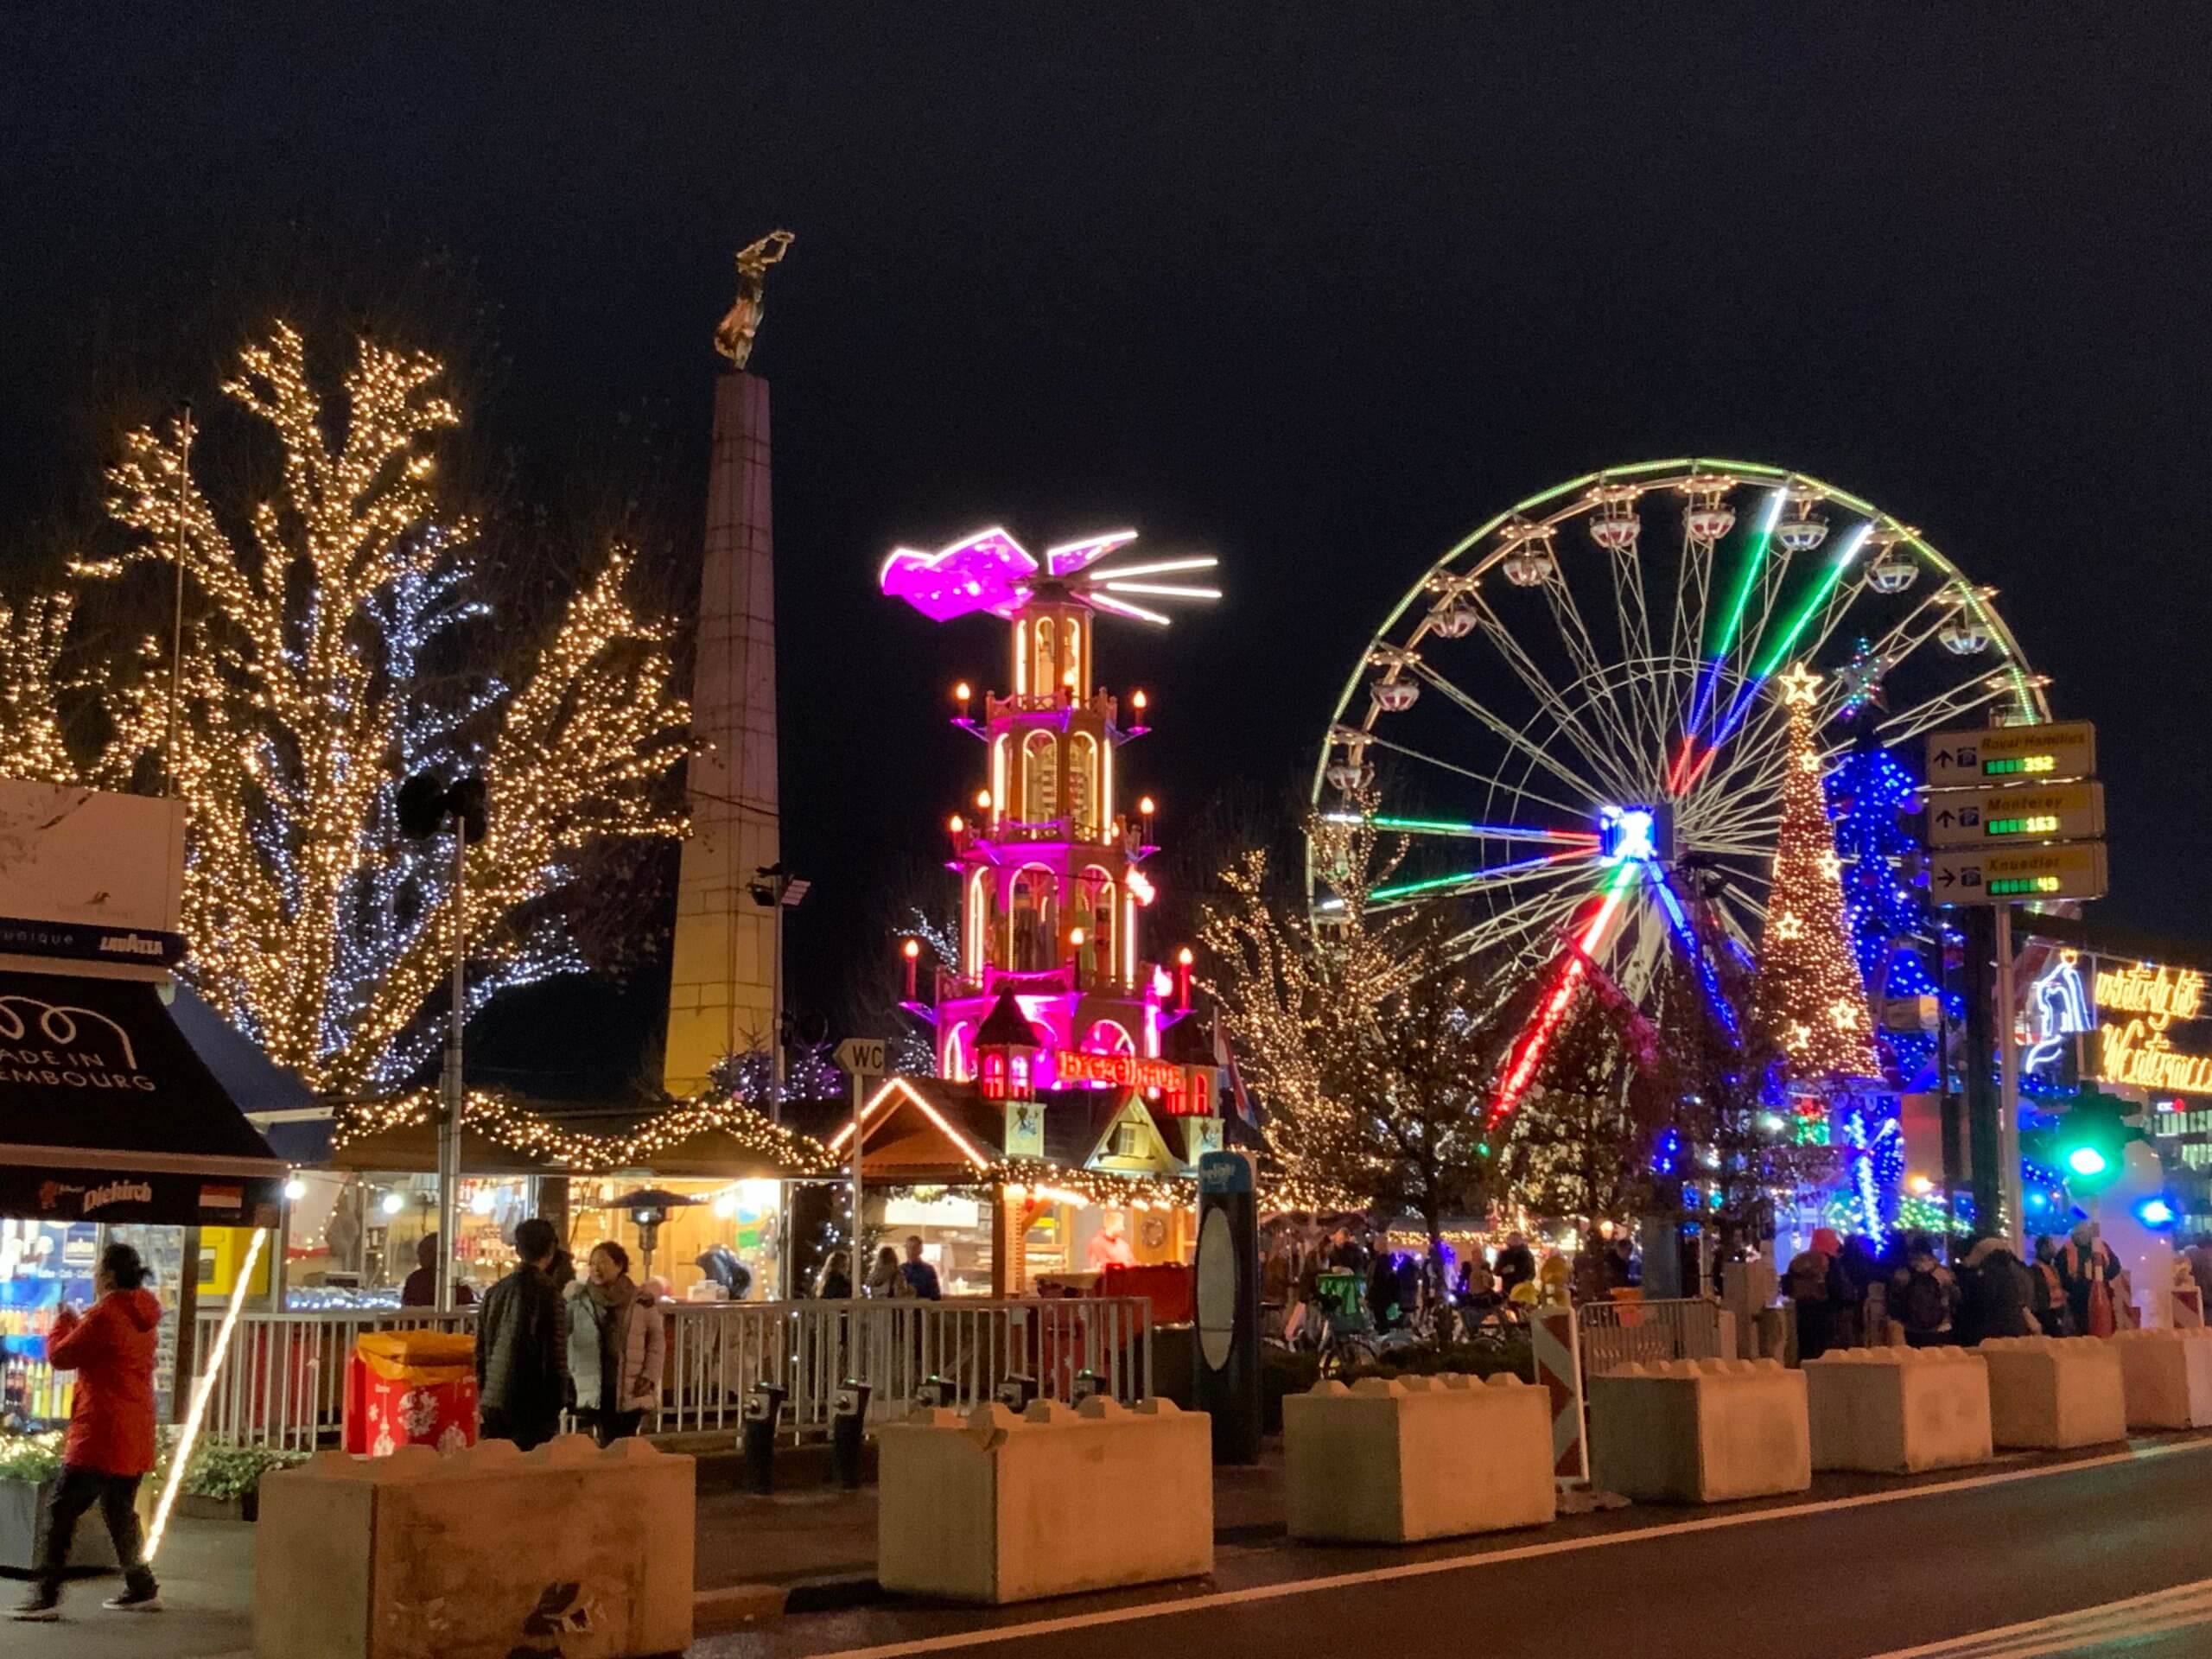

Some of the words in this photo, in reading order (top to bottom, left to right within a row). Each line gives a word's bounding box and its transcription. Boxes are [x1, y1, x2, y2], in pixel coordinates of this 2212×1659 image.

[1981, 735, 2019, 750] Royal
[2024, 732, 2084, 747] Hamilius
[1987, 796, 2063, 810] Monterey
[1989, 855, 2060, 871] Knuedler
[99, 933, 164, 955] LAVAZZA
[67, 1052, 105, 1068] IN
[852, 1045, 882, 1069] WC
[83, 1179, 153, 1213] Diekirch
